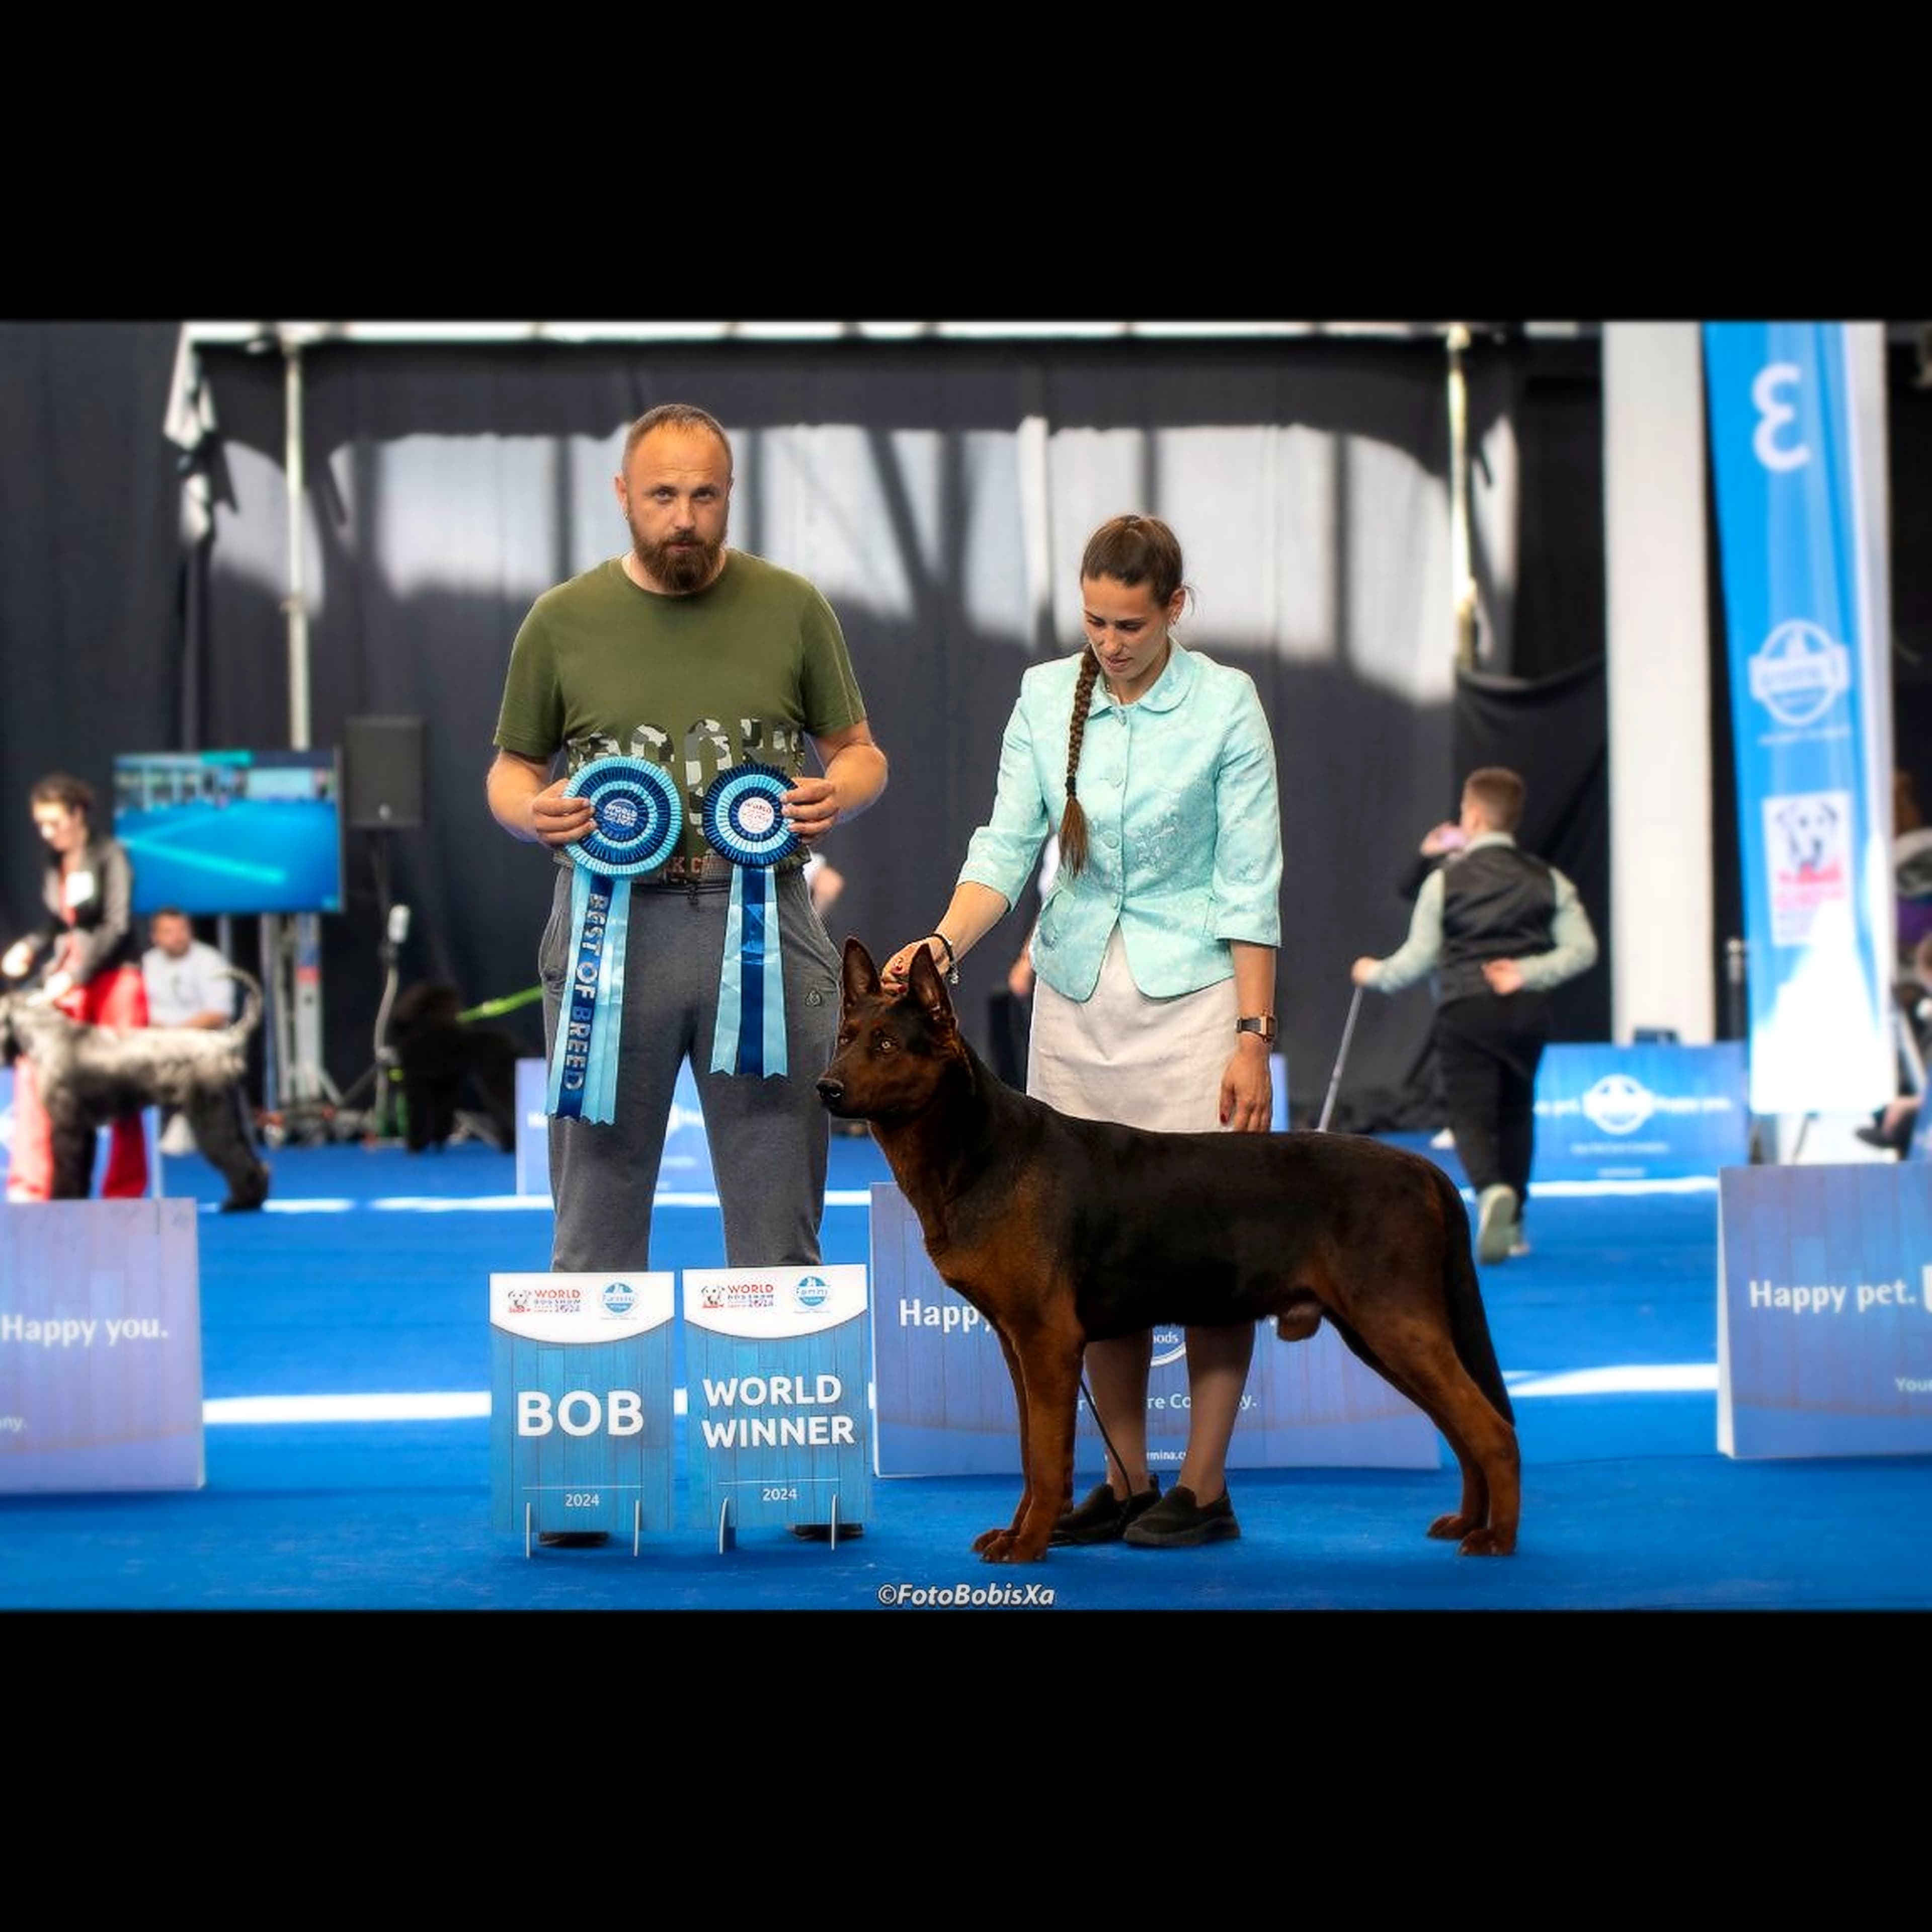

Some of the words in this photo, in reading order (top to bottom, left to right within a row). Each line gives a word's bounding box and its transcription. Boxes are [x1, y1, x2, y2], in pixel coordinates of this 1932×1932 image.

[582, 893, 608, 957] BEST
[575, 961, 598, 999] OF
[564, 1006, 594, 1090] BREED
[534, 1289, 581, 1299] WORLD
[728, 1284, 774, 1294] WORLD
[1750, 1280, 1846, 1314] Happy
[1858, 1278, 1916, 1313] pet.
[1, 1314, 97, 1348] Happy
[105, 1318, 168, 1346] you.
[703, 1375, 841, 1406] WORLD
[518, 1390, 644, 1436] BOB
[702, 1416, 854, 1448] WINNER
[565, 1493, 599, 1507] 2024
[762, 1488, 797, 1501] 2024
